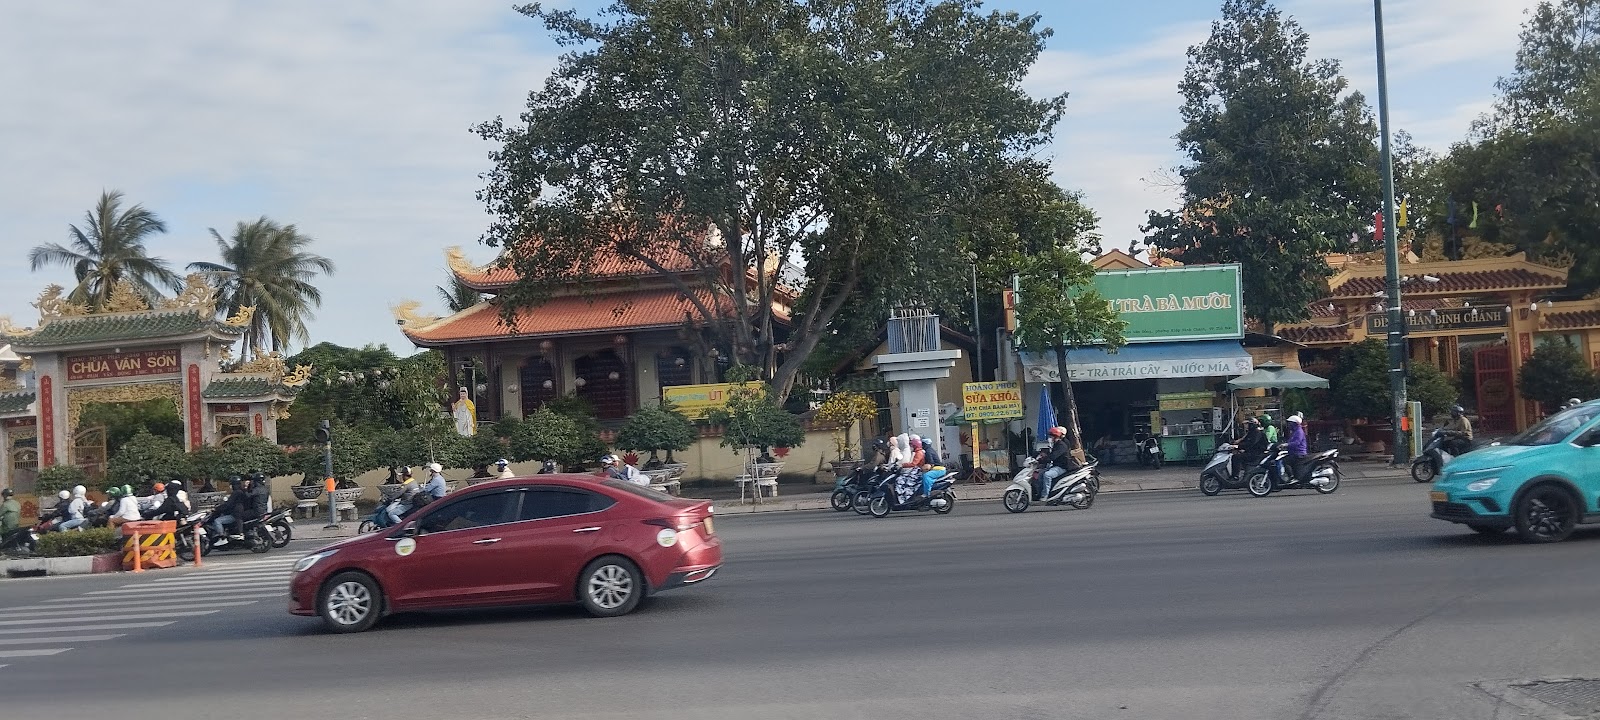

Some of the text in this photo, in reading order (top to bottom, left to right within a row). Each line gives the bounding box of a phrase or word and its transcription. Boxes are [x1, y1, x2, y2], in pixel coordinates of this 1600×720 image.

[1116, 295, 1155, 313] TRÀ
[1156, 294, 1181, 311] BÀ
[1182, 292, 1232, 311] MƯỜI
[1435, 312, 1460, 325] BÌNH
[1463, 310, 1501, 323] CHÁNH
[114, 357, 141, 371] VÂN
[147, 354, 177, 368] SƠN
[1049, 369, 1077, 379] CE
[1087, 366, 1109, 377] TRÀ
[1111, 365, 1136, 376] TRÁI
[1140, 364, 1160, 376] CÂY
[1171, 361, 1205, 374] NƯỚC
[1208, 360, 1230, 372] MÍA
[989, 390, 1021, 402] KHÓA
